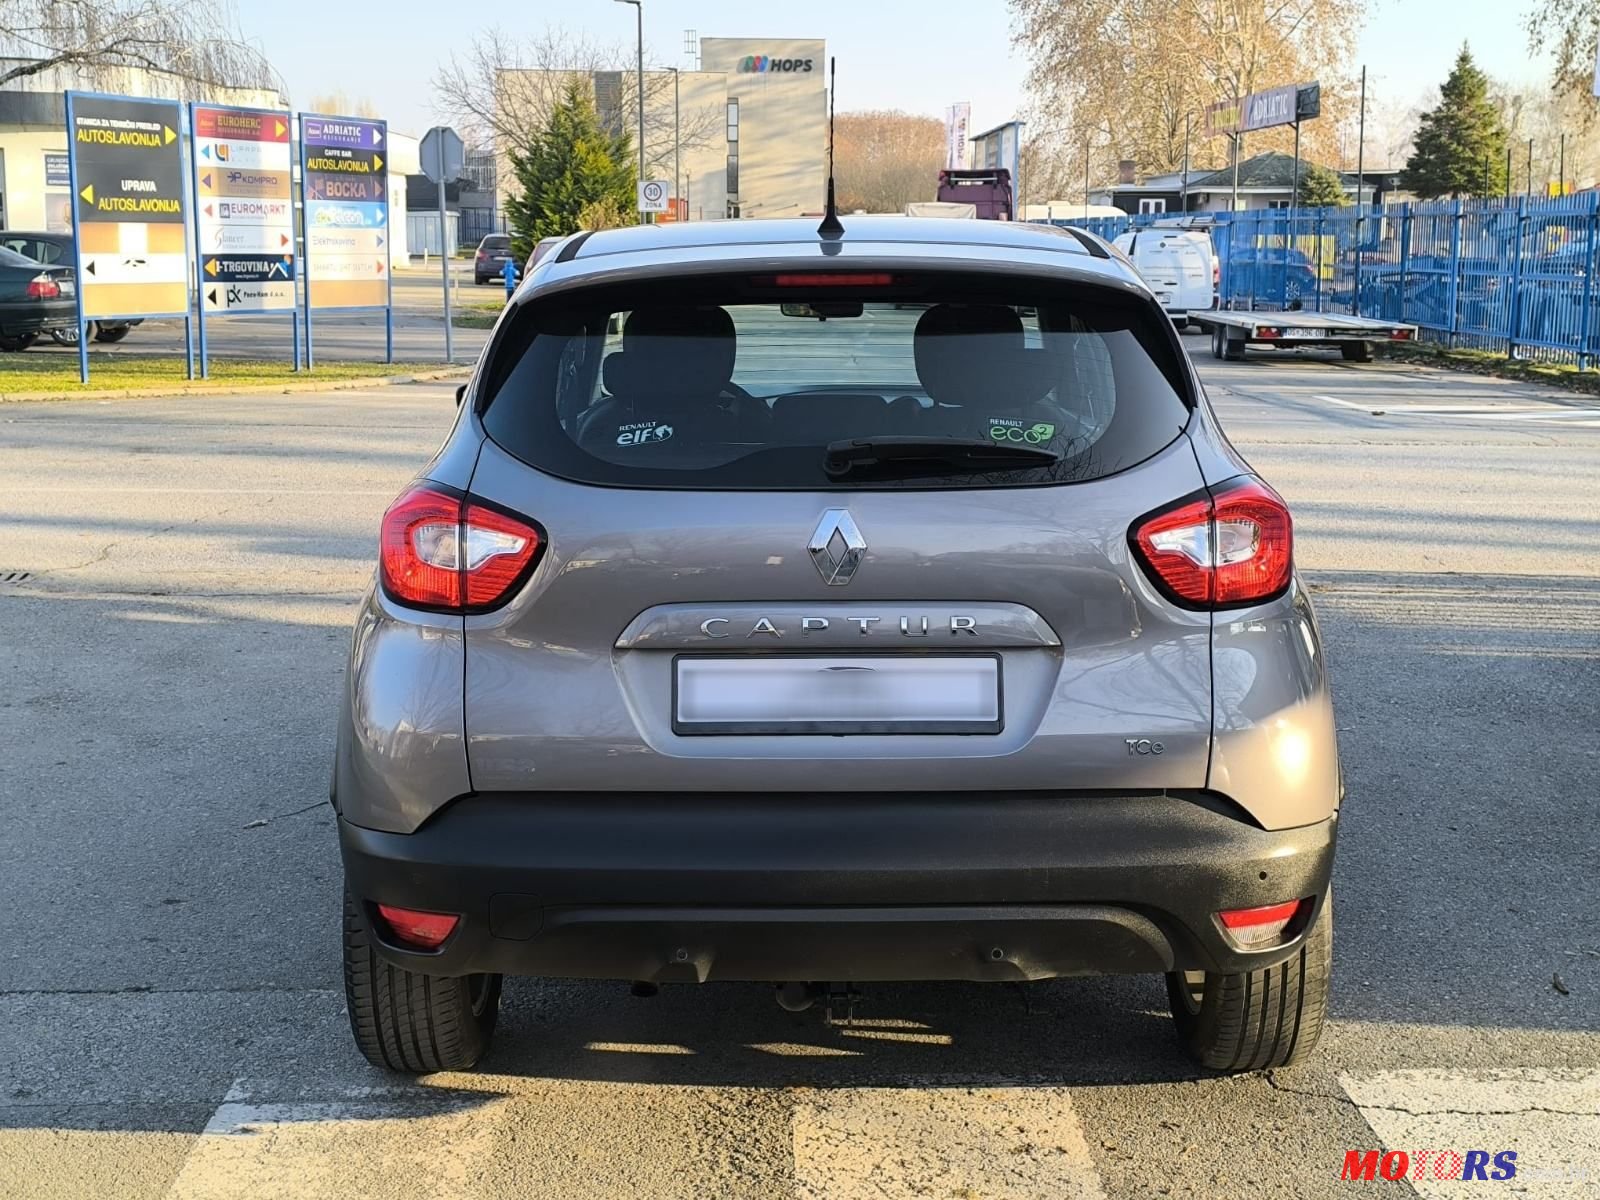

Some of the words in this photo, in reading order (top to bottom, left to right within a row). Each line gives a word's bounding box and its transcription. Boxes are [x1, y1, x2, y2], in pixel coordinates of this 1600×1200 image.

[770, 58, 813, 72] HOPS
[1253, 94, 1288, 121] ADRIATIC
[217, 115, 261, 129] EUROHERC
[77, 128, 162, 147] AUTOSLAVONIJA
[323, 124, 362, 137] ADRIATIC
[307, 157, 369, 172] AUTOSLAVONIJA
[121, 179, 157, 192] UPRAVA
[326, 181, 367, 198] BOCKA
[647, 187, 659, 197] 30
[98, 198, 181, 213] AUTOSLAVONIJA
[231, 203, 286, 216] EUROMARKT
[619, 421, 656, 431] RENAULT
[989, 418, 1023, 427] RENAULT
[616, 428, 652, 445] elf
[700, 616, 980, 639] CAPTUR
[1125, 739, 1165, 756] TCe
